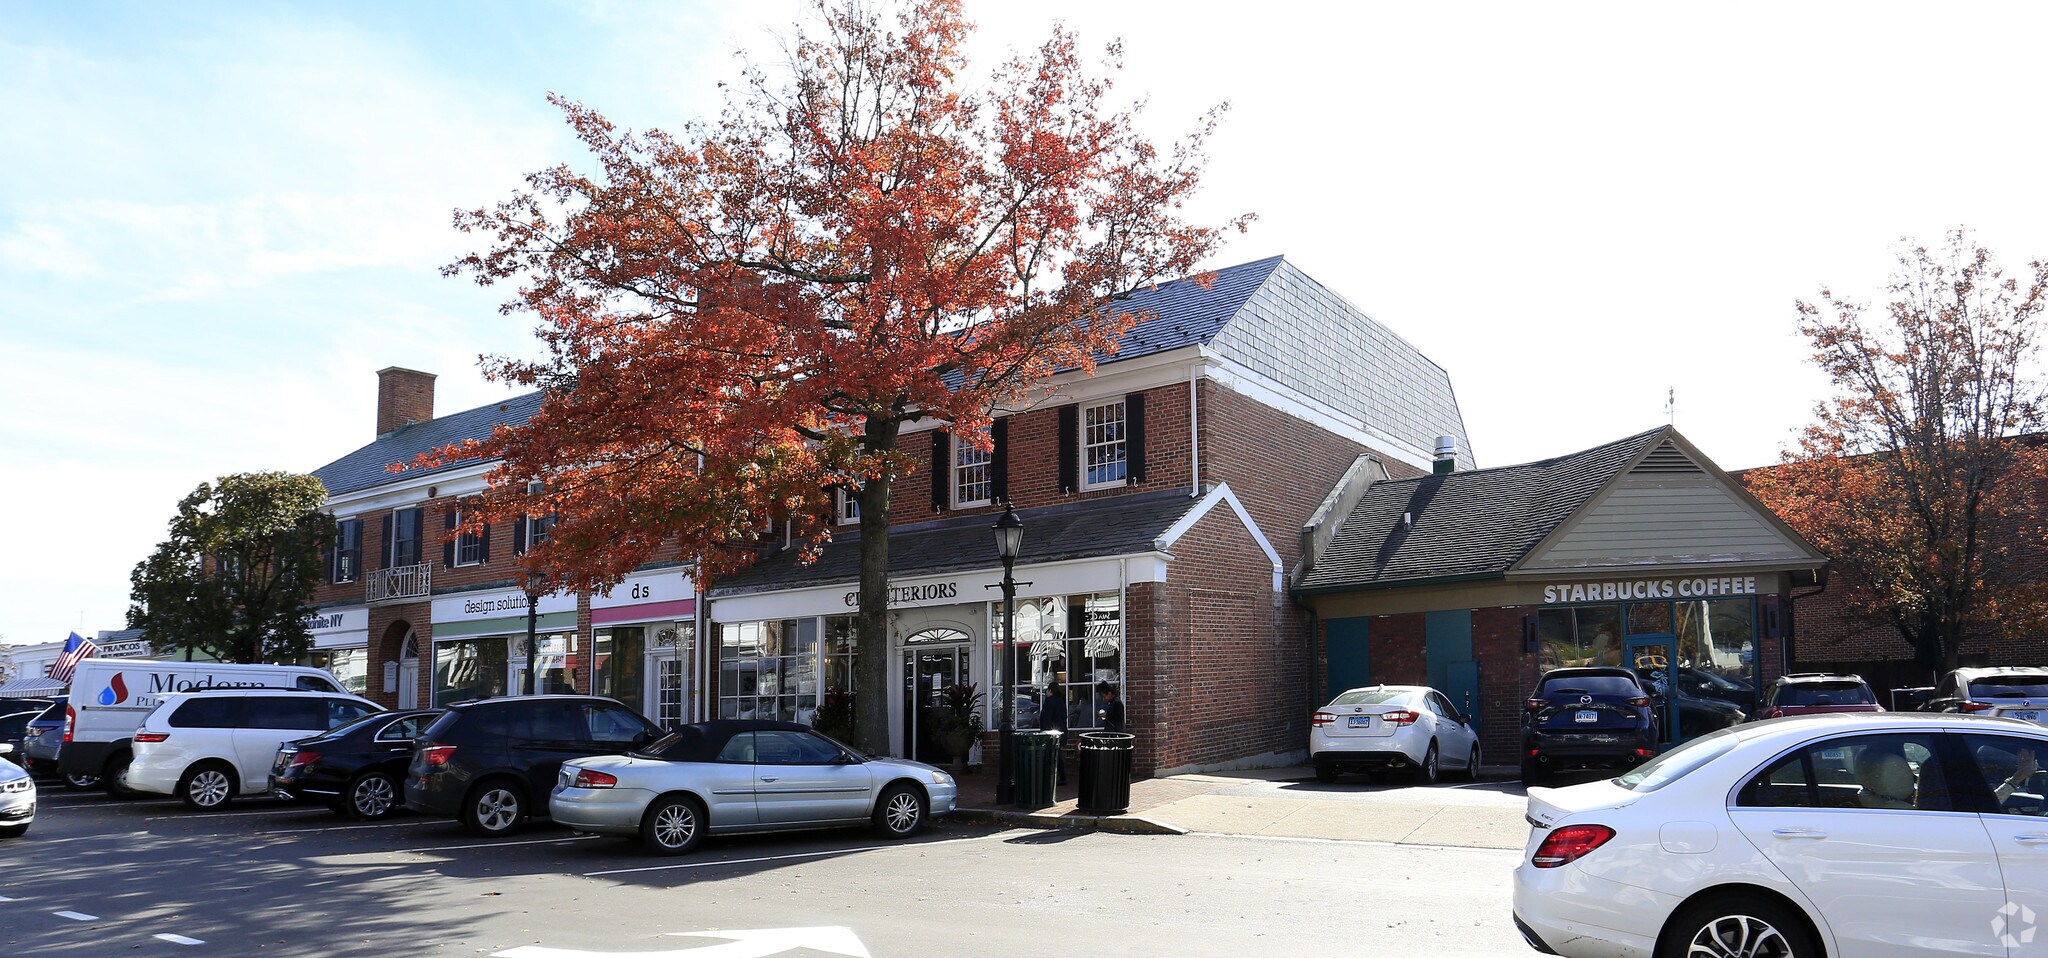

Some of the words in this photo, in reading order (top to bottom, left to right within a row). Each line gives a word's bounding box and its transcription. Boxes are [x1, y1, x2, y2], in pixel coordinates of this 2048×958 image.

[1544, 580, 1674, 603] STARBUCKS
[1678, 577, 1756, 597] COFFEE
[464, 600, 495, 615] design
[330, 613, 344, 628] NY
[103, 642, 140, 653] FRANCOS
